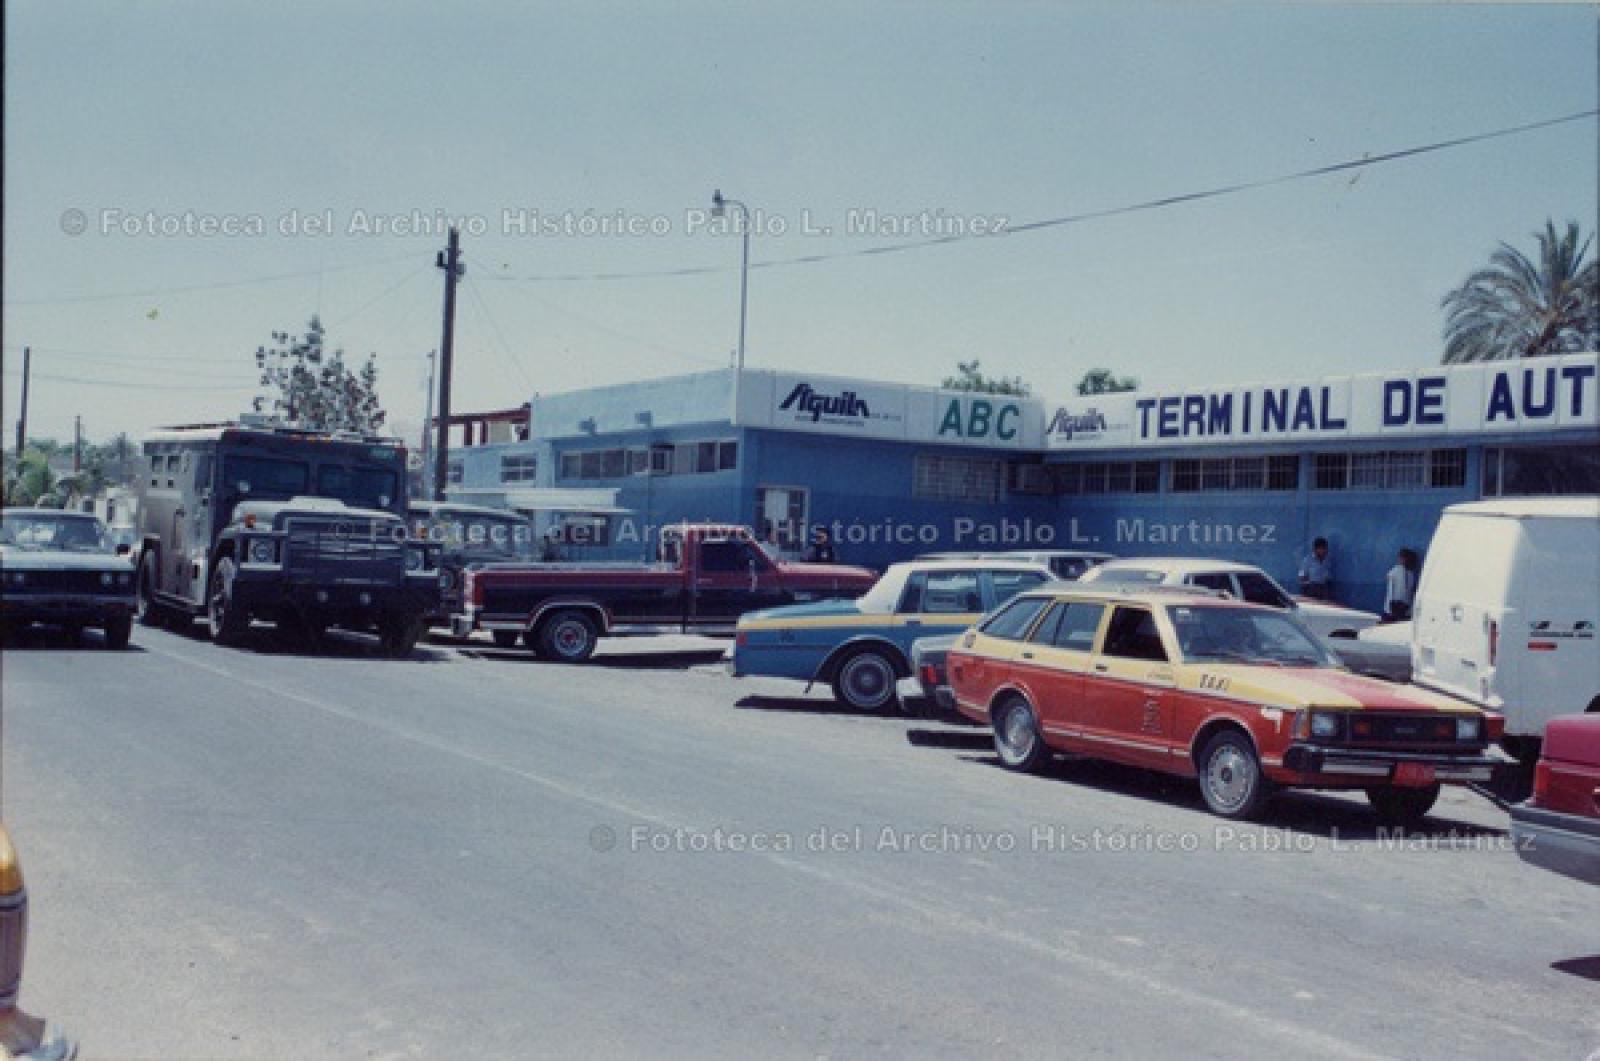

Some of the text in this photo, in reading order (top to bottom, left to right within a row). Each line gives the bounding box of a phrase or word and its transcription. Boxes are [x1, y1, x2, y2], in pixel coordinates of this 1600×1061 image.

[938, 399, 1020, 440] ABC
[1136, 365, 1596, 438] TERMINAL DE AUT
